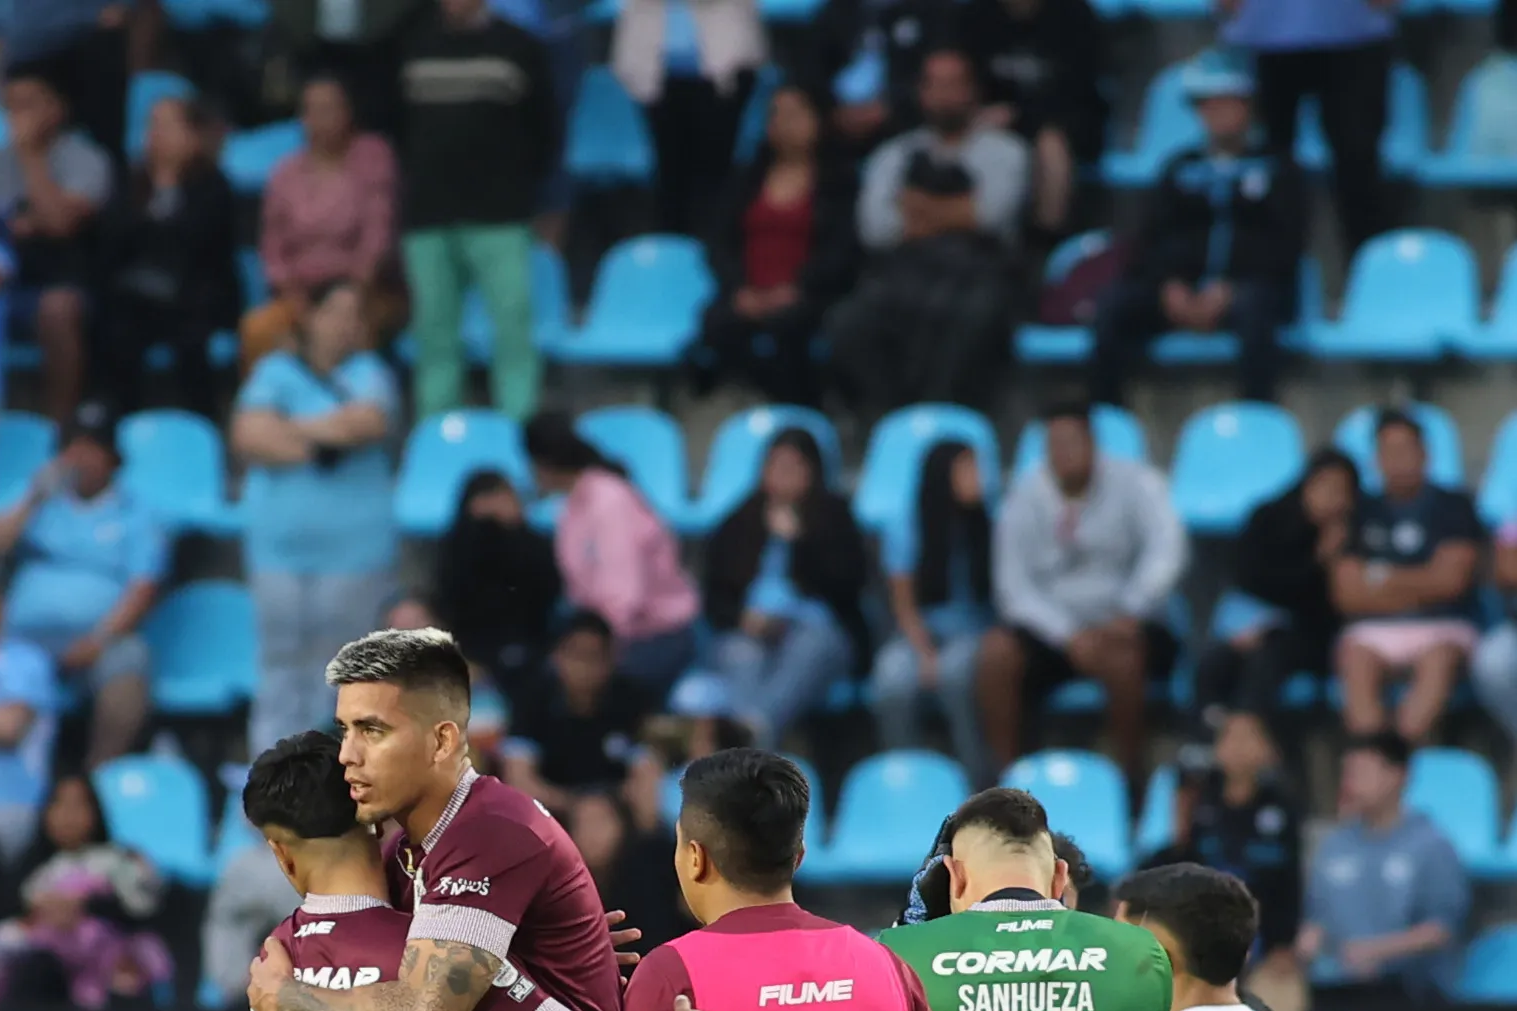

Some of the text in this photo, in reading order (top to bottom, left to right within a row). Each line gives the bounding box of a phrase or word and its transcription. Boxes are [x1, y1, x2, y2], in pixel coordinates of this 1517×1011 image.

[996, 919, 1054, 933] FIUME
[932, 947, 1108, 975] CORMAR
[758, 979, 854, 1007] FIUME
